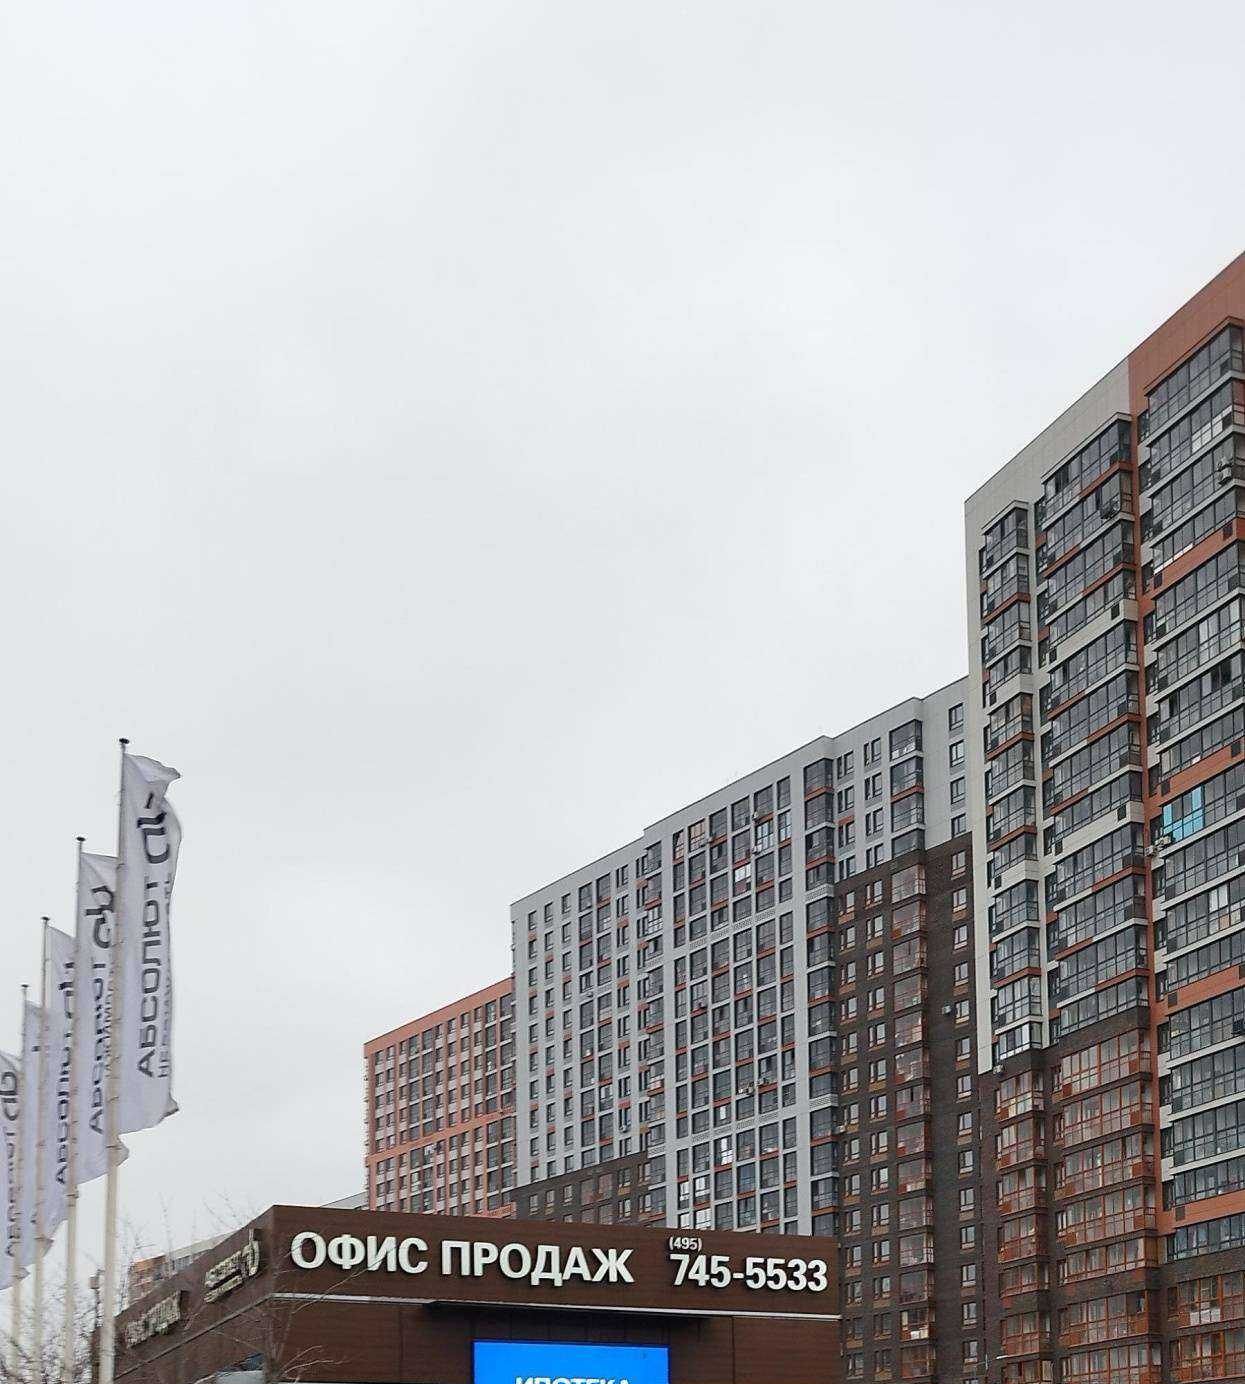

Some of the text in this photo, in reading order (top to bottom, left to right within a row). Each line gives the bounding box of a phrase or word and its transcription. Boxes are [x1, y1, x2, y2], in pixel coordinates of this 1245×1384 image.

[137, 872, 162, 1078] АБСОЛЮТ
[290, 1231, 635, 1286] ОФИС ПРОДАЖ
[668, 1237, 703, 1251] (495)
[669, 1253, 828, 1292] 745-5533
